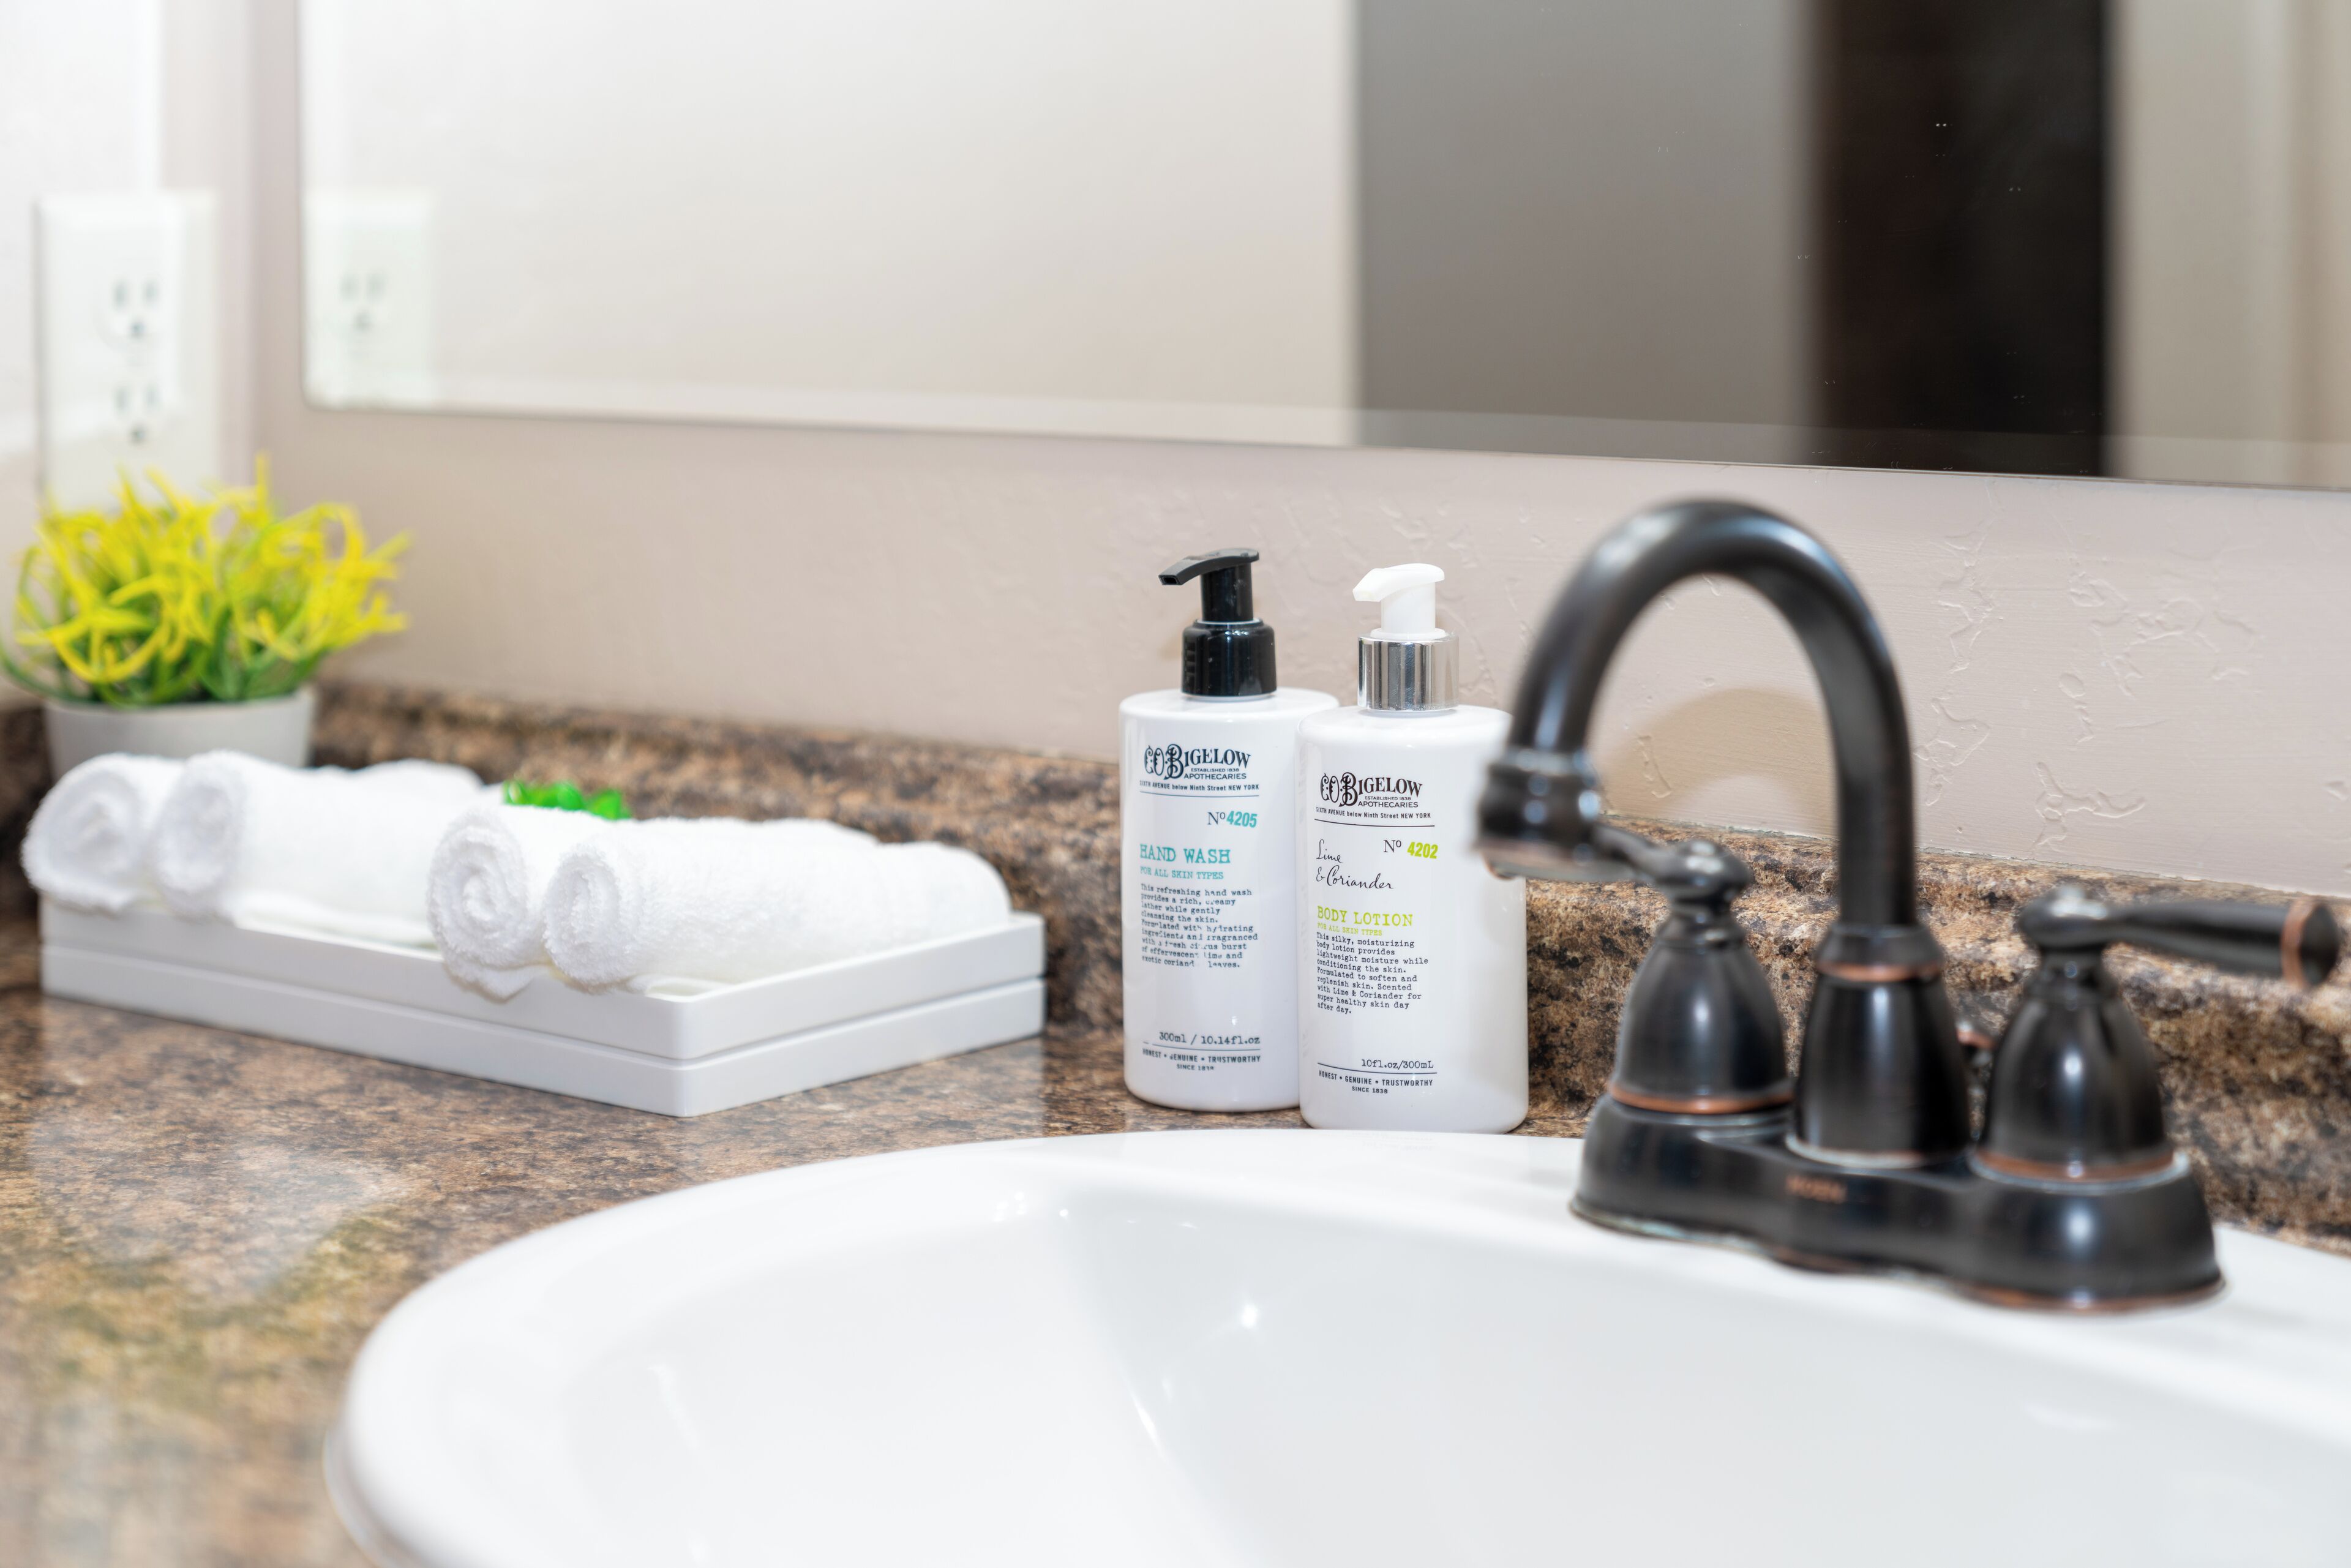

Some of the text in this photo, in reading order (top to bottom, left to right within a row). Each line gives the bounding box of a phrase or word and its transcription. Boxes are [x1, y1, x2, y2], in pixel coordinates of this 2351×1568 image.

[1226, 811, 1257, 828] 4205
[1140, 844, 1230, 864] HAND WASH
[1316, 839, 1343, 863] Lime
[1407, 841, 1438, 859] 4202
[1140, 866, 1224, 880] FOR ALL SKIN TYPES
[1316, 865, 1394, 890] & Coriander
[1141, 893, 1169, 902] provides
[1157, 887, 1200, 897] refreshing
[1142, 901, 1161, 910] lather
[1142, 910, 1174, 921] cleansing
[1318, 906, 1413, 926] BODY LOTION
[1316, 932, 1414, 948] This silky, moisturizing
[1317, 940, 1395, 956] body lotion provides
[1317, 950, 1357, 962] lightweight
[1317, 959, 1361, 972] conditioning
[1317, 967, 1354, 979] Formulated
[1318, 976, 1349, 988] replenish
[1318, 985, 1330, 993] with
[1333, 987, 1349, 996] Lime
[1360, 991, 1403, 999] Coriander
[1318, 994, 1333, 1003] super
[1337, 997, 1366, 1008] healthy
[1393, 1001, 1409, 1010] day
[1318, 1002, 1352, 1014] after day.
[1160, 1032, 1187, 1043] 300ml
[1201, 1036, 1260, 1045] 10.14fl.oz
[1361, 1059, 1433, 1069] 10fl.oz/300mL
[1319, 1071, 1337, 1080] HONEST
[1345, 1075, 1371, 1085] GENUINE
